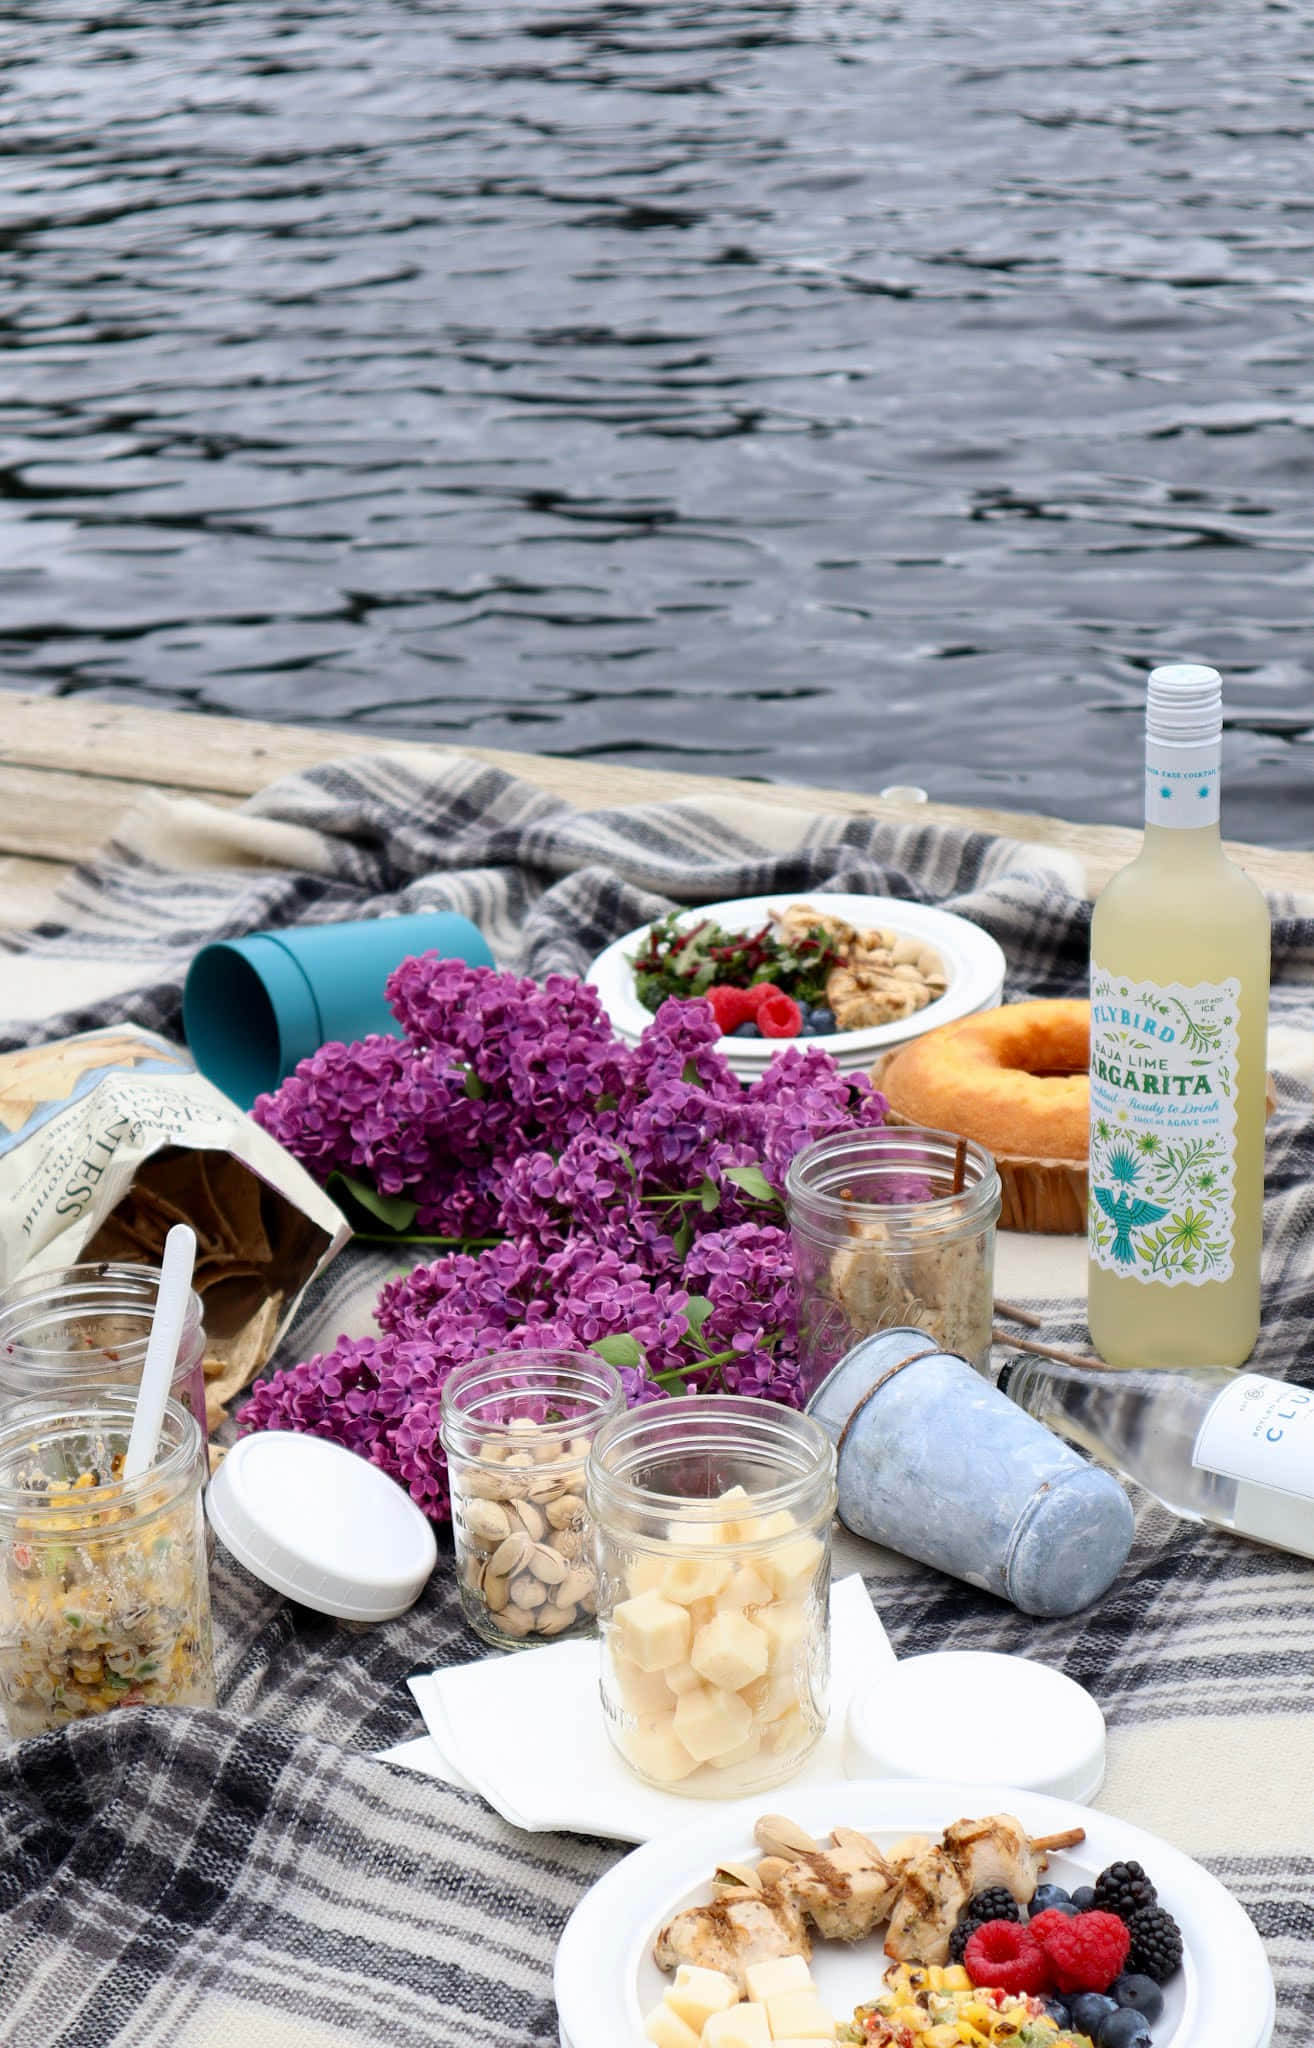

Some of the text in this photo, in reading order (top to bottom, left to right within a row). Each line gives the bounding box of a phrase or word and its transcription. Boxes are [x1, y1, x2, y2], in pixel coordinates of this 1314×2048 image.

[1201, 1004, 1216, 1013] ICE
[1093, 1005, 1176, 1043] FLYBIRD
[1128, 1055, 1169, 1070] LIME
[1091, 1052, 1213, 1096] ARGARITA
[1127, 1096, 1165, 1115] Ready
[1167, 1103, 1179, 1113] to
[1180, 1099, 1219, 1113] Drink
[1167, 1119, 1199, 1127] AGAVE
[1265, 1388, 1314, 1443] CLU
